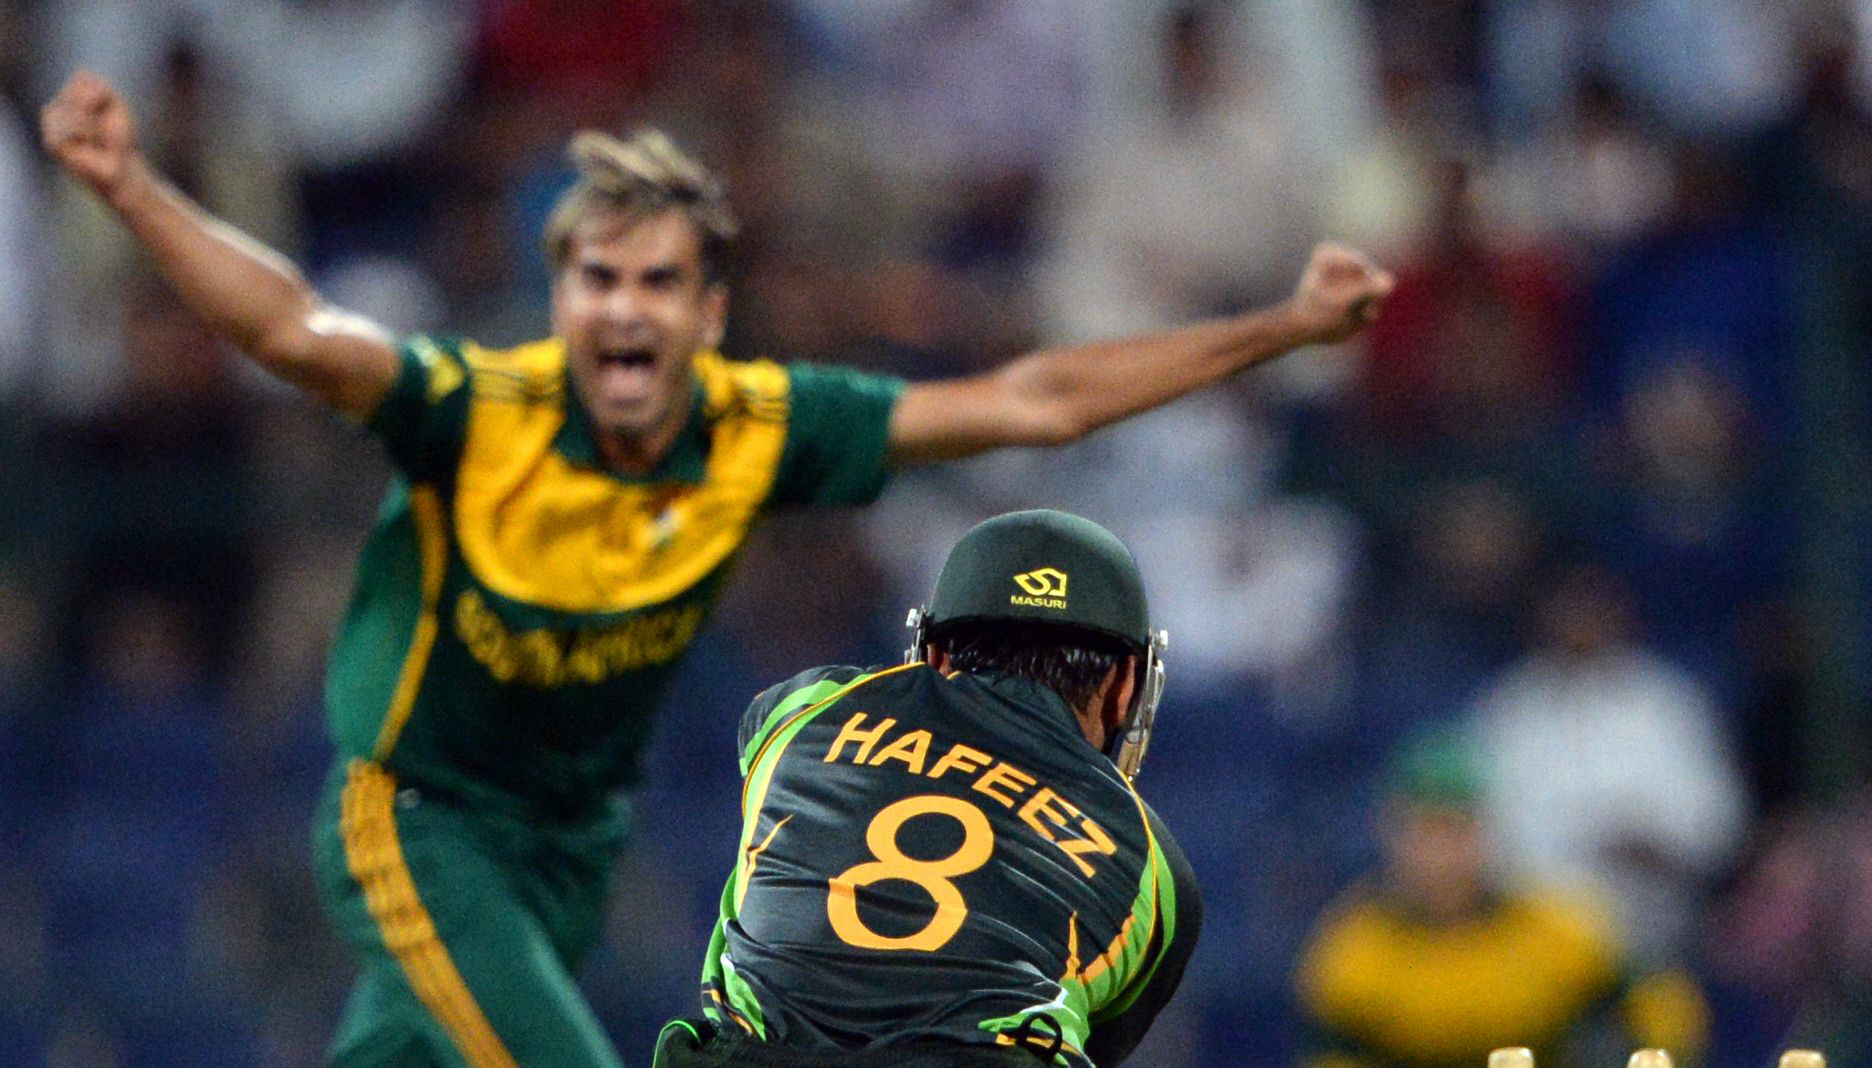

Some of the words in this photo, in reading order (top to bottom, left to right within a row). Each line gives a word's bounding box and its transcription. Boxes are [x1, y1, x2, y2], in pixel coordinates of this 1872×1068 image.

[1010, 595, 1067, 610] MASURI
[823, 712, 1117, 879] HAFEEZ
[827, 795, 995, 952] 8
